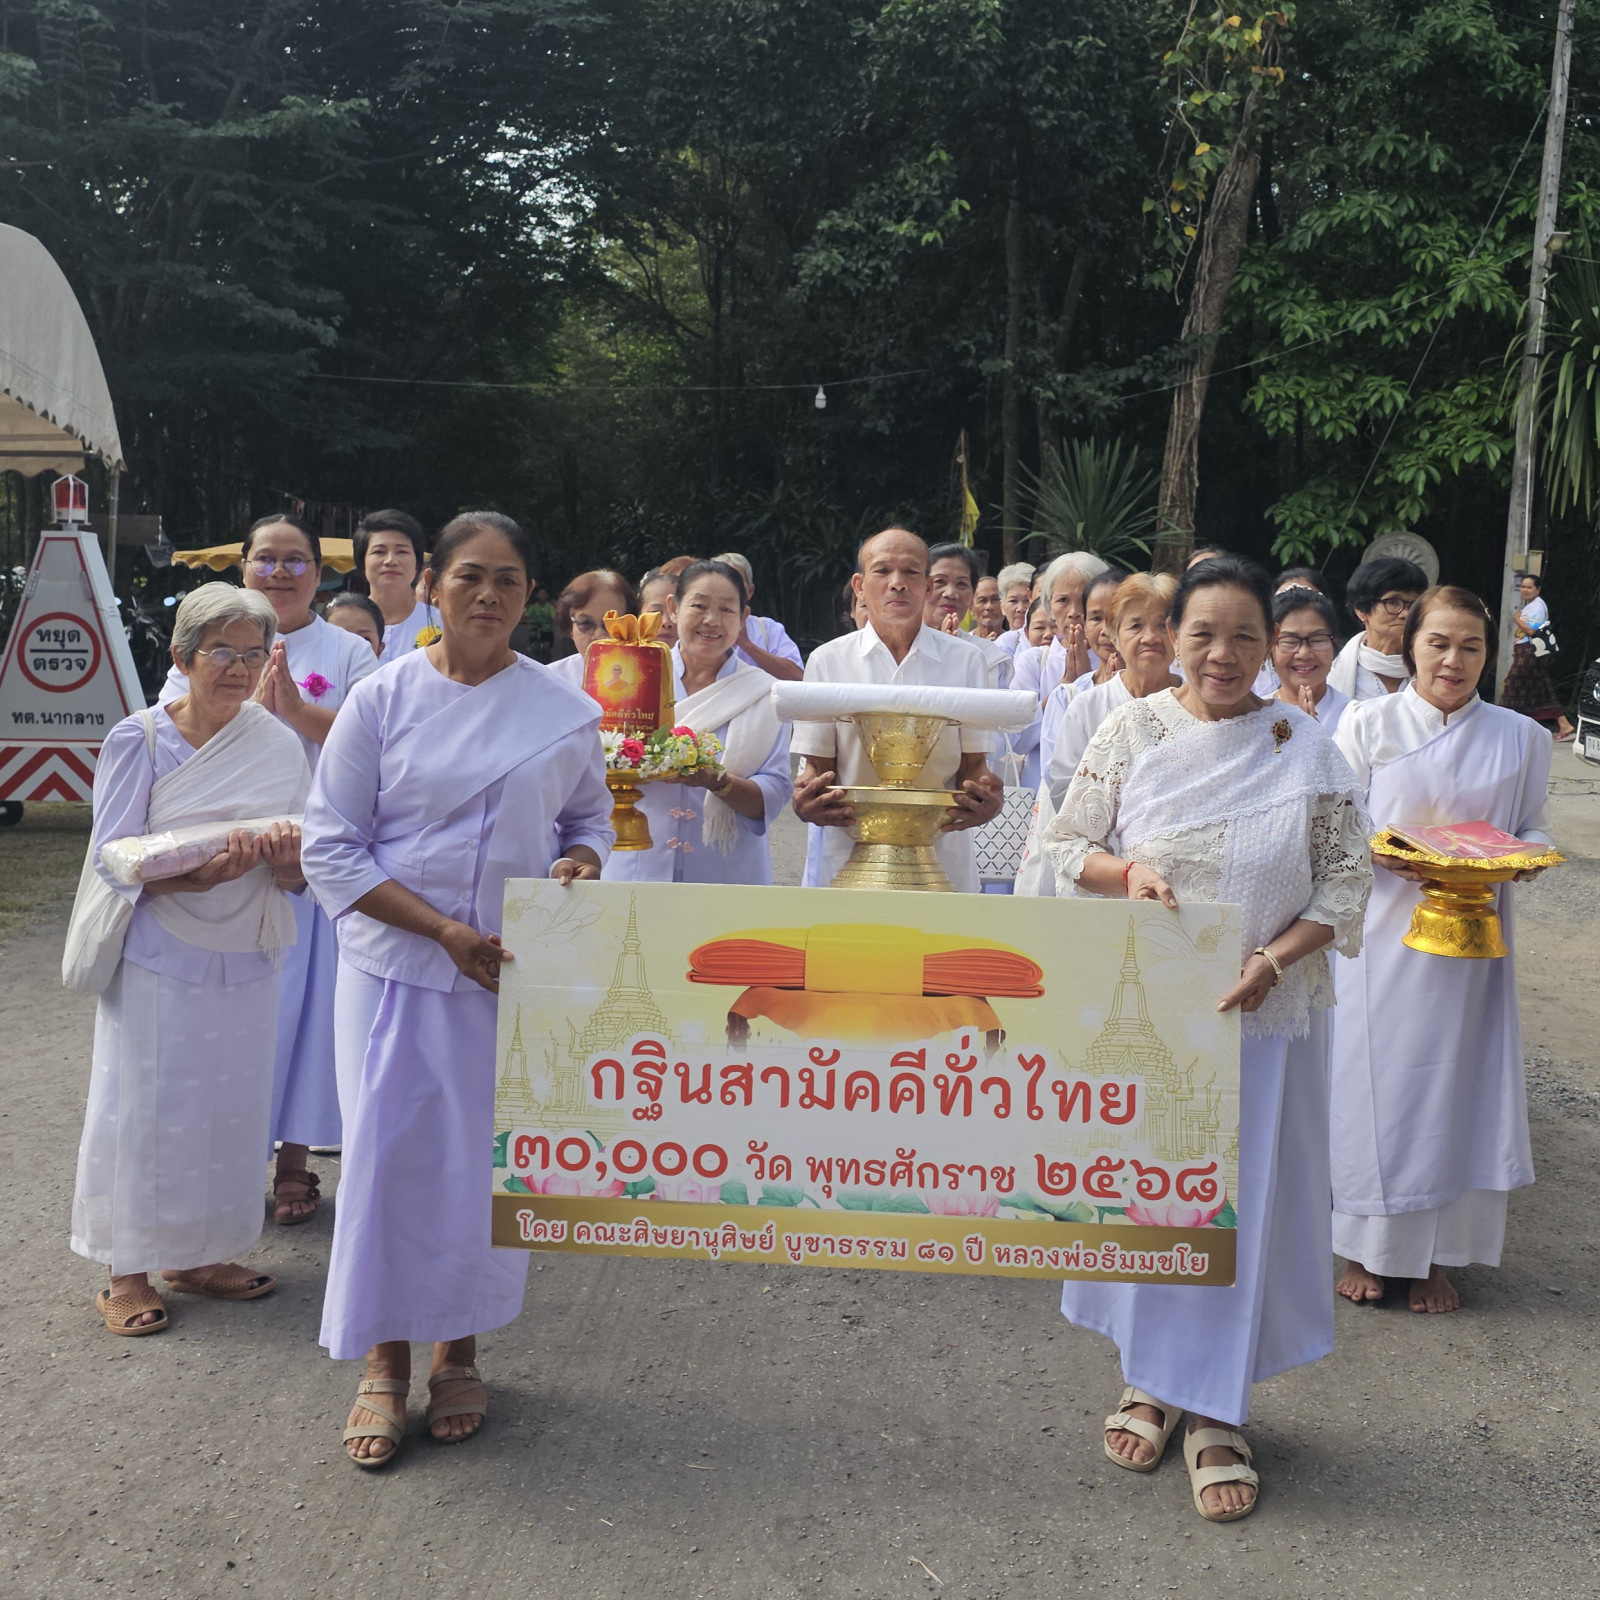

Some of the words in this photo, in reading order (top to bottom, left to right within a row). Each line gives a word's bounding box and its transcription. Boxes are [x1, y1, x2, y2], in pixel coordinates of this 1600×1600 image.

[36, 628, 81, 649] หยุด
[33, 657, 87, 671] ตรวจ
[11, 711, 105, 725] ทต.นากลาง
[591, 1035, 1136, 1125] กฐินสามัคคีทั่วไทย
[514, 1135, 728, 1181] ๓๐,๐๐๐
[746, 1140, 792, 1182] วัด
[806, 1148, 1015, 1199] พุทธศักราช
[1034, 1153, 1218, 1203] ๒๕๖๘
[519, 1213, 565, 1240] โดย
[576, 1219, 774, 1257] คณะศิษยานุศิษย์
[785, 1233, 906, 1261] บูชาธรรม
[917, 1242, 954, 1262] ๘๑
[966, 1236, 983, 1262] ปี
[995, 1240, 1206, 1273] หลวงพ่อธัมมชโย
